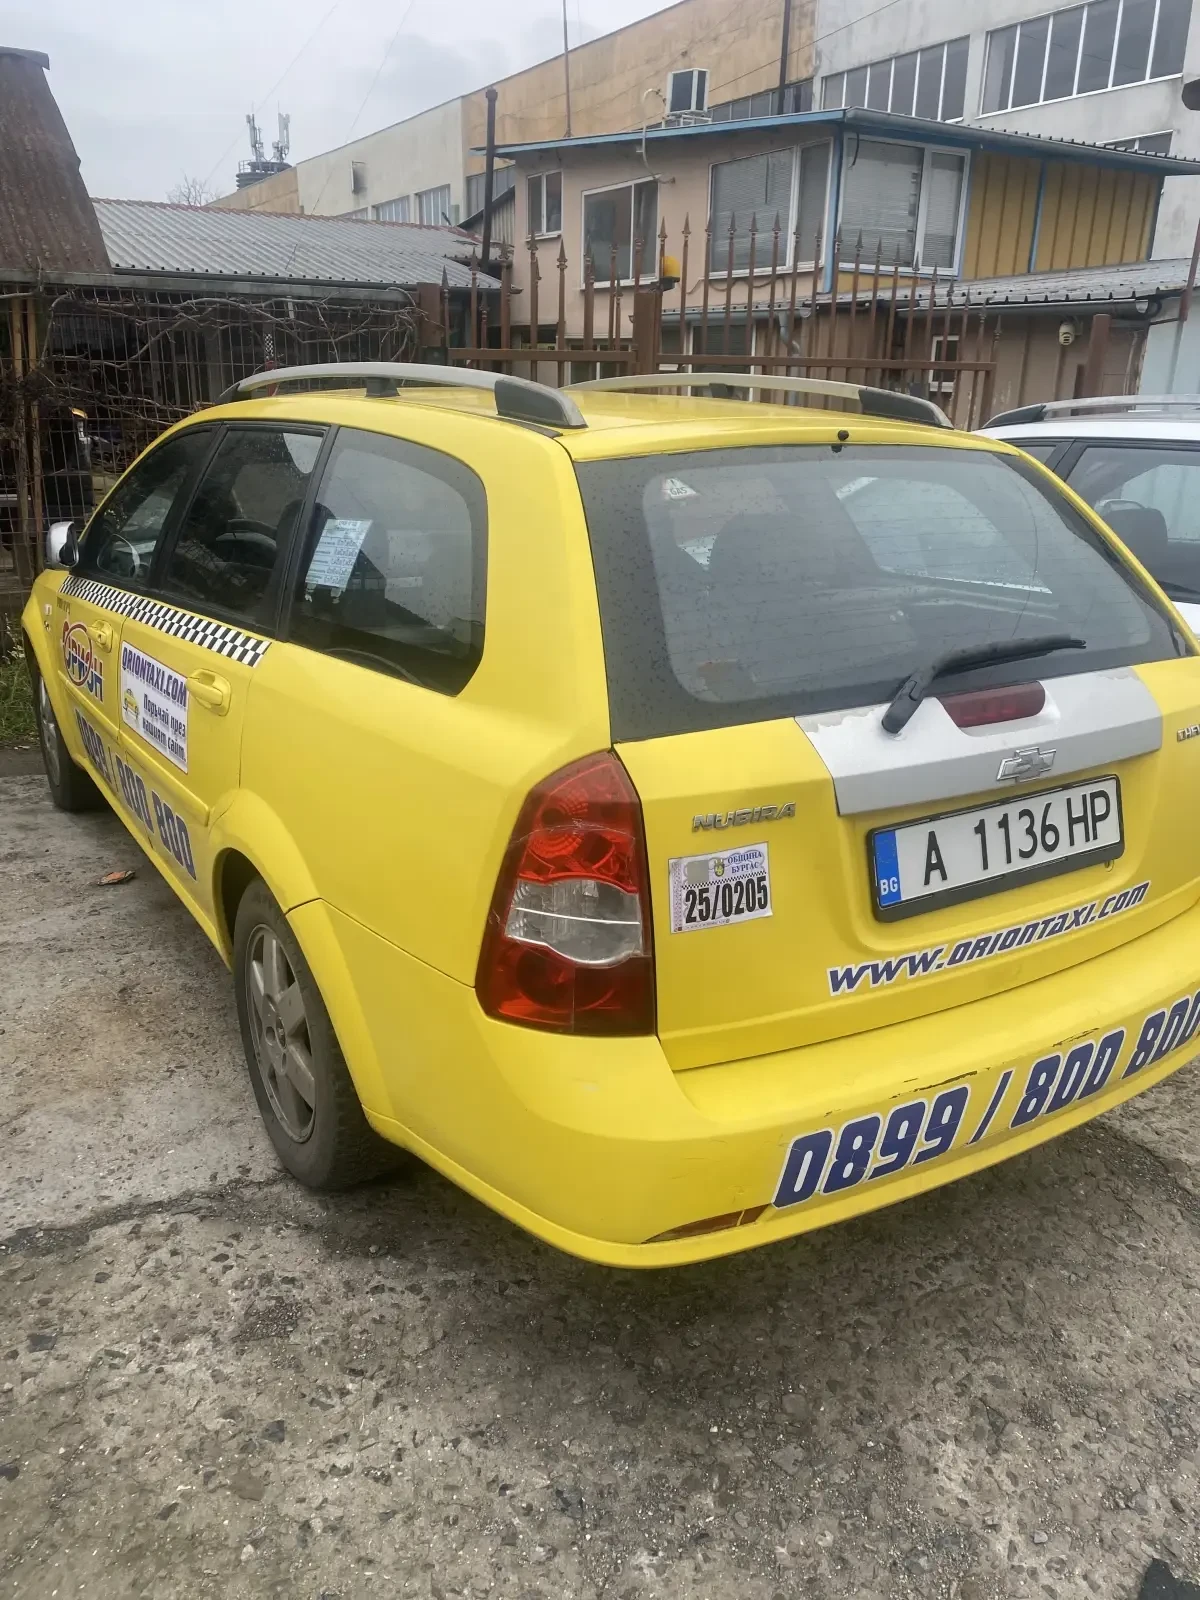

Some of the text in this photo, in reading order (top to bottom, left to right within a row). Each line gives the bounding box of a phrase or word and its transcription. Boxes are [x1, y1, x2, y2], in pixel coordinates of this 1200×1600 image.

[669, 486, 688, 496] GAS
[122, 646, 187, 708] ORIONTAXI.COM
[143, 693, 186, 738] Поръчай през
[115, 752, 155, 834] 800
[151, 789, 197, 882] 800
[692, 801, 796, 833] NUBIRA
[923, 789, 1112, 886] A 1136 HP
[727, 851, 762, 864] ОБЩИНА
[731, 861, 760, 874] БУРГАС
[684, 875, 769, 924] 25/0205
[879, 877, 899, 896] BG
[771, 988, 1200, 1209] 0899 / 800 800
